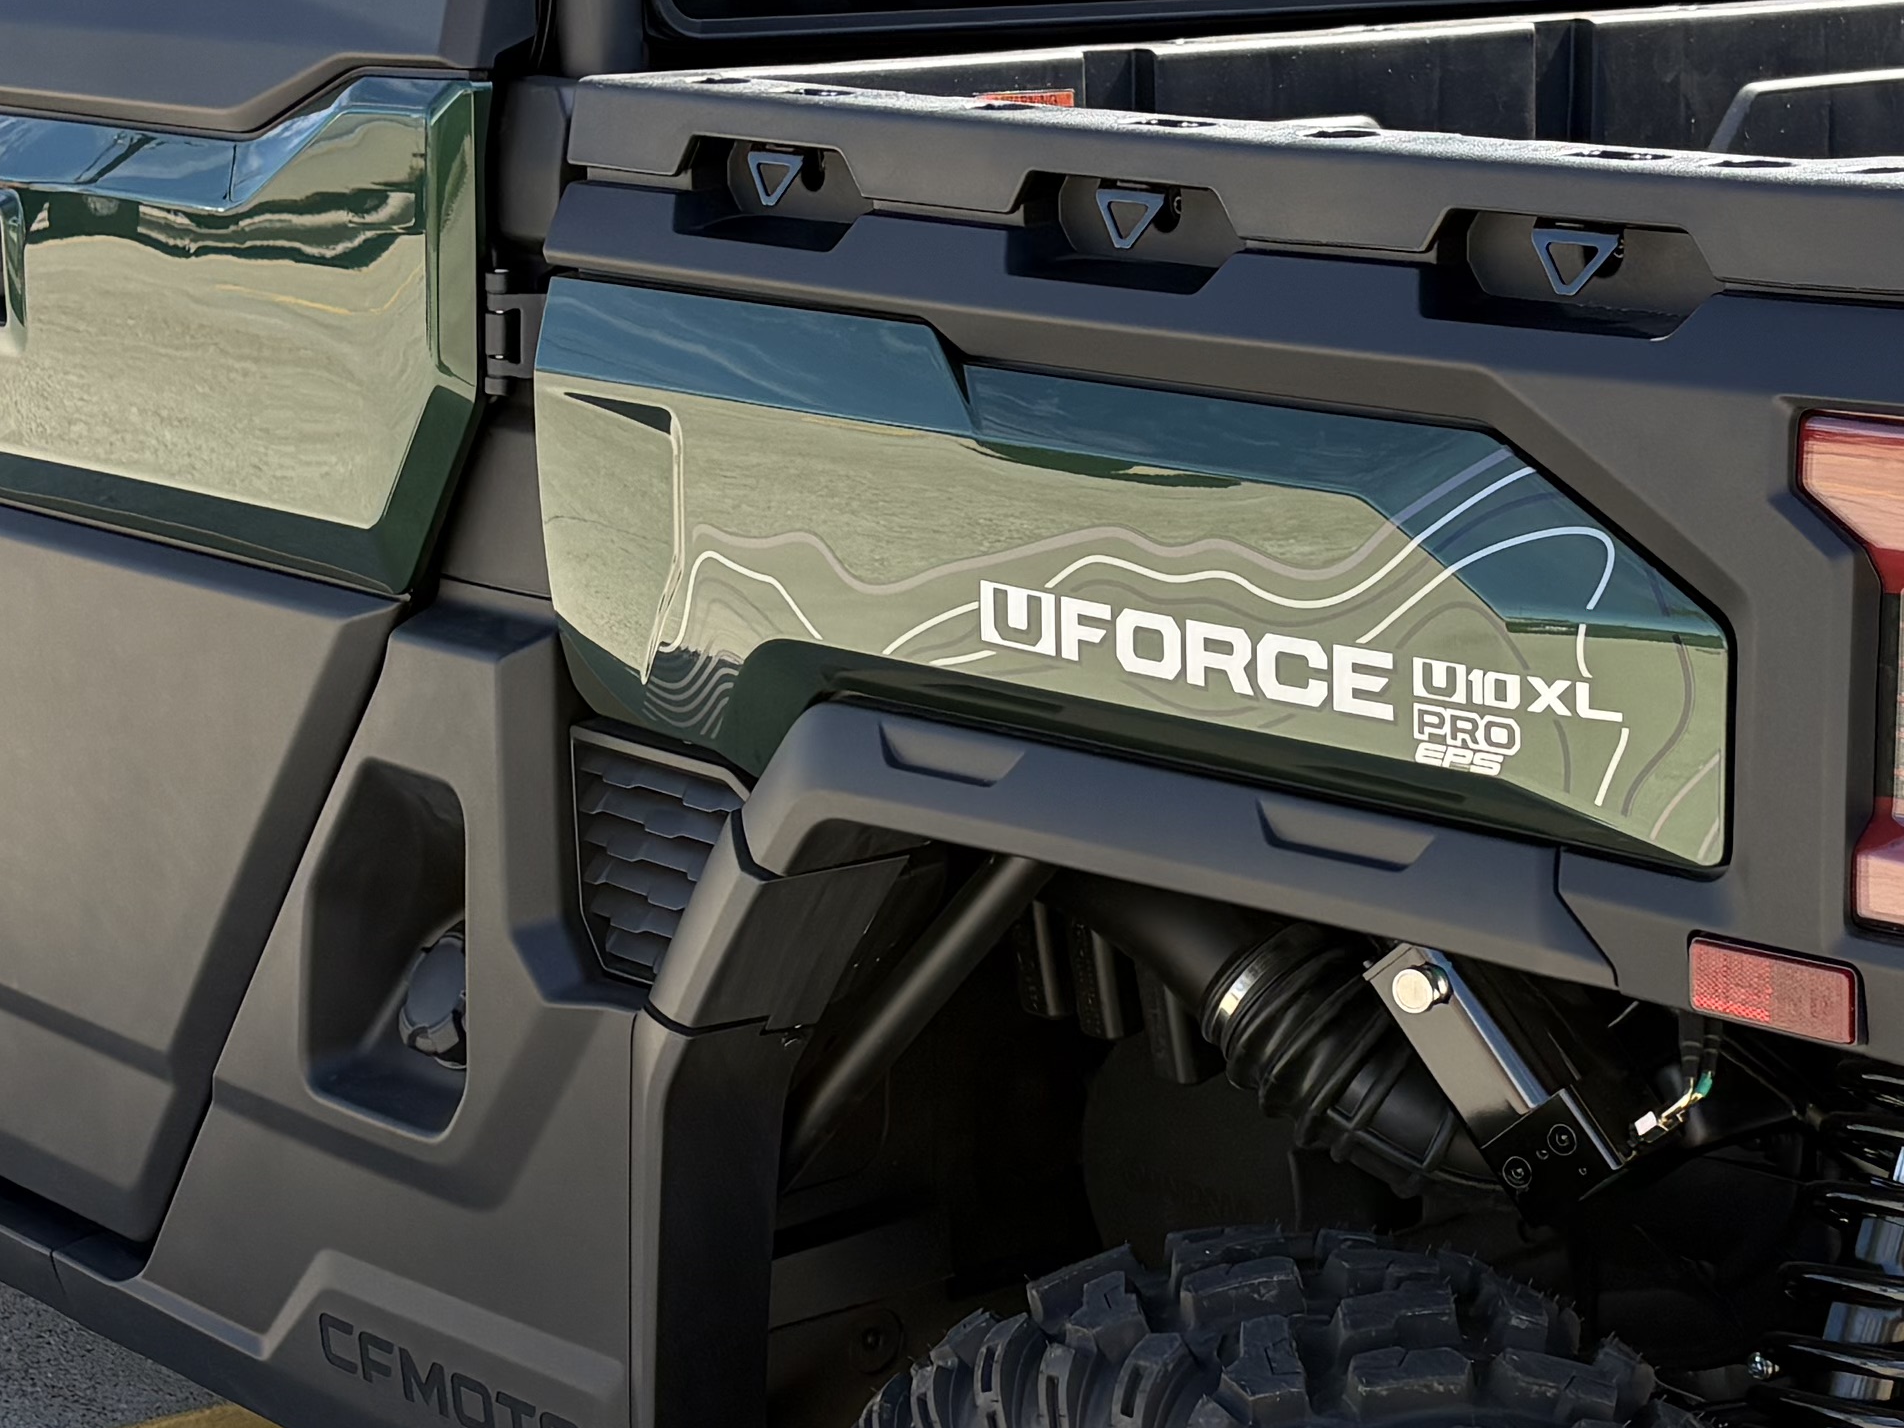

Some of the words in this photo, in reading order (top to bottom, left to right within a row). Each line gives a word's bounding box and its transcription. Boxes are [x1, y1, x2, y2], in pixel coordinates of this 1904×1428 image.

[979, 579, 1394, 721] UFORCE
[1413, 702, 1521, 757] PRO
[1414, 742, 1505, 776] EPS
